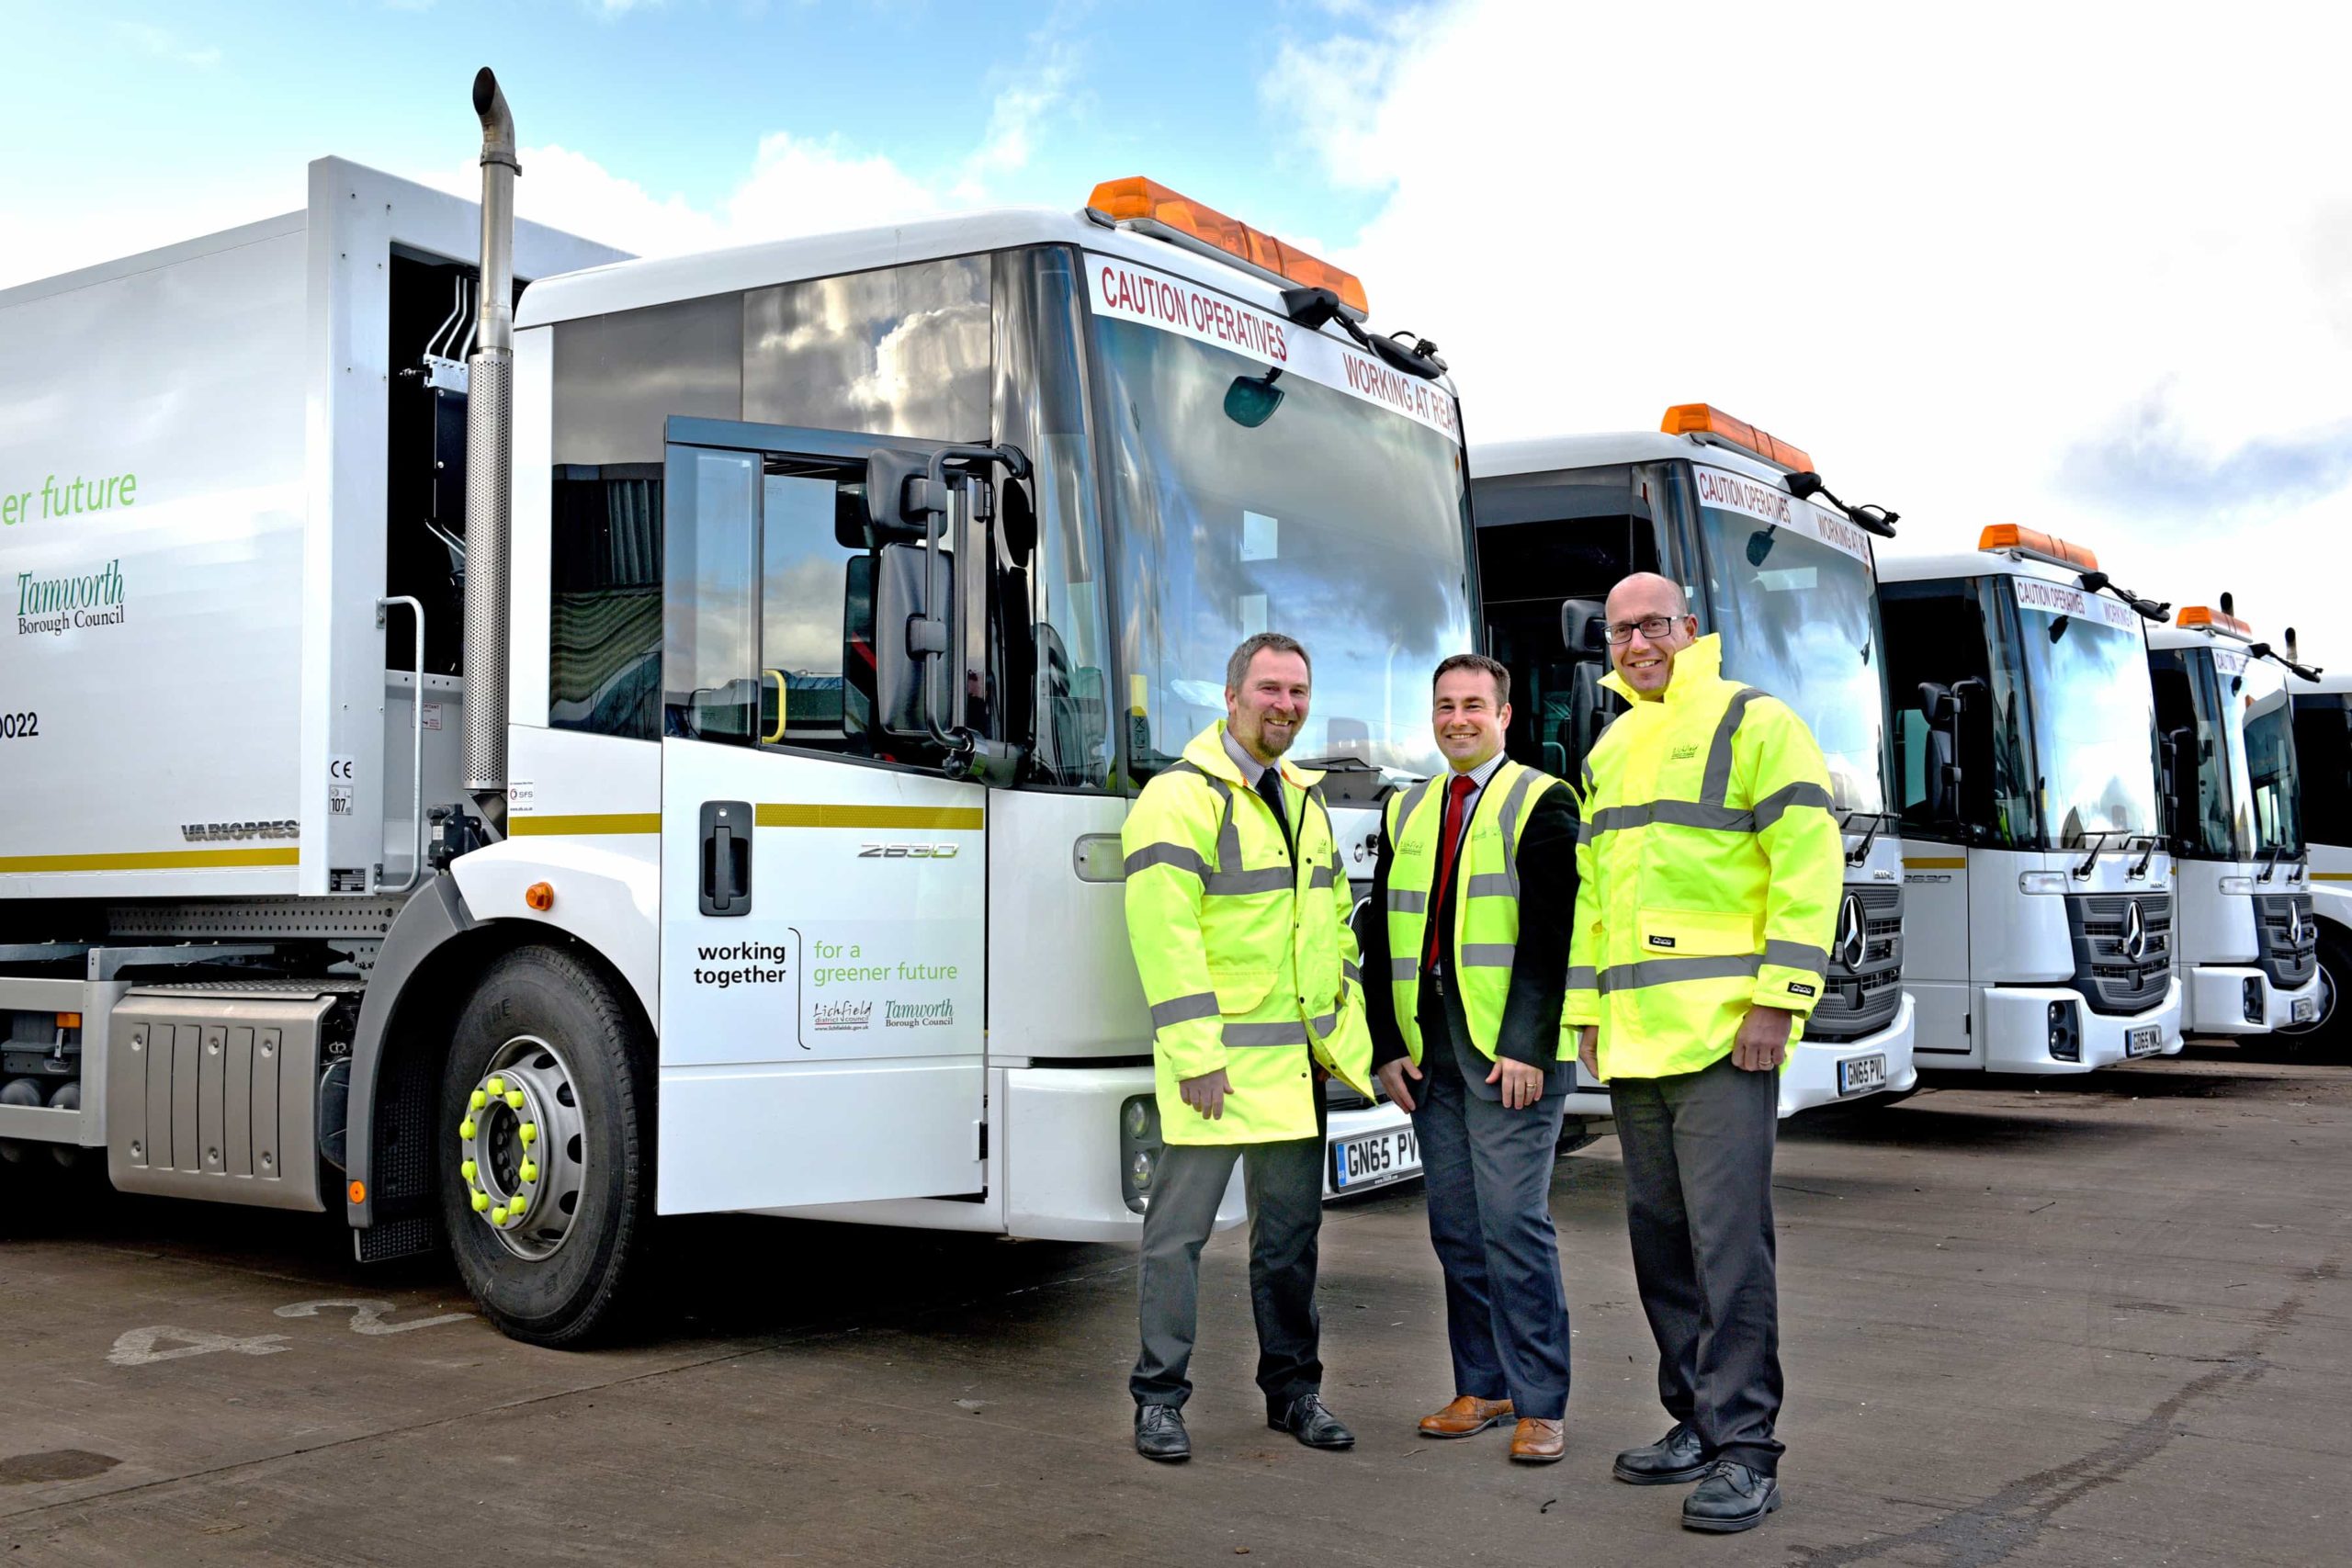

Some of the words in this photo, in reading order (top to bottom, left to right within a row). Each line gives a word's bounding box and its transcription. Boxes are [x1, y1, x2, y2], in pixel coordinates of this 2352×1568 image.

[1102, 266, 1189, 328] CAUTION
[1191, 293, 1287, 363] OPERATIVES
[1342, 352, 1413, 412] WORKING
[1415, 383, 1430, 420] AT
[40, 473, 137, 519] future
[1700, 472, 1745, 509] CAUTION
[1744, 483, 1792, 525] OPERATIVES
[1815, 512, 1852, 549] WORKING
[17, 558, 125, 616] Tamworth
[2017, 581, 2052, 607] CAUTION
[2050, 589, 2086, 615] OPERATIVES
[18, 612, 71, 637] Borough
[74, 604, 125, 628] Council
[331, 797, 346, 812] 107
[181, 819, 300, 842] VARIOPRES
[697, 942, 786, 964] working
[814, 940, 843, 959] for
[850, 945, 861, 958] a
[694, 965, 786, 988] together
[813, 966, 891, 987] greener
[897, 962, 957, 980] future
[813, 1000, 872, 1020] Lichfield
[885, 998, 954, 1019] Tamworth
[886, 1019, 920, 1029] Borough
[922, 1017, 954, 1026] Council
[1848, 1060, 1869, 1086] GN65
[1870, 1058, 1884, 1082] PVL
[1348, 1136, 1390, 1178] GN65
[1397, 1132, 1416, 1166] PV
